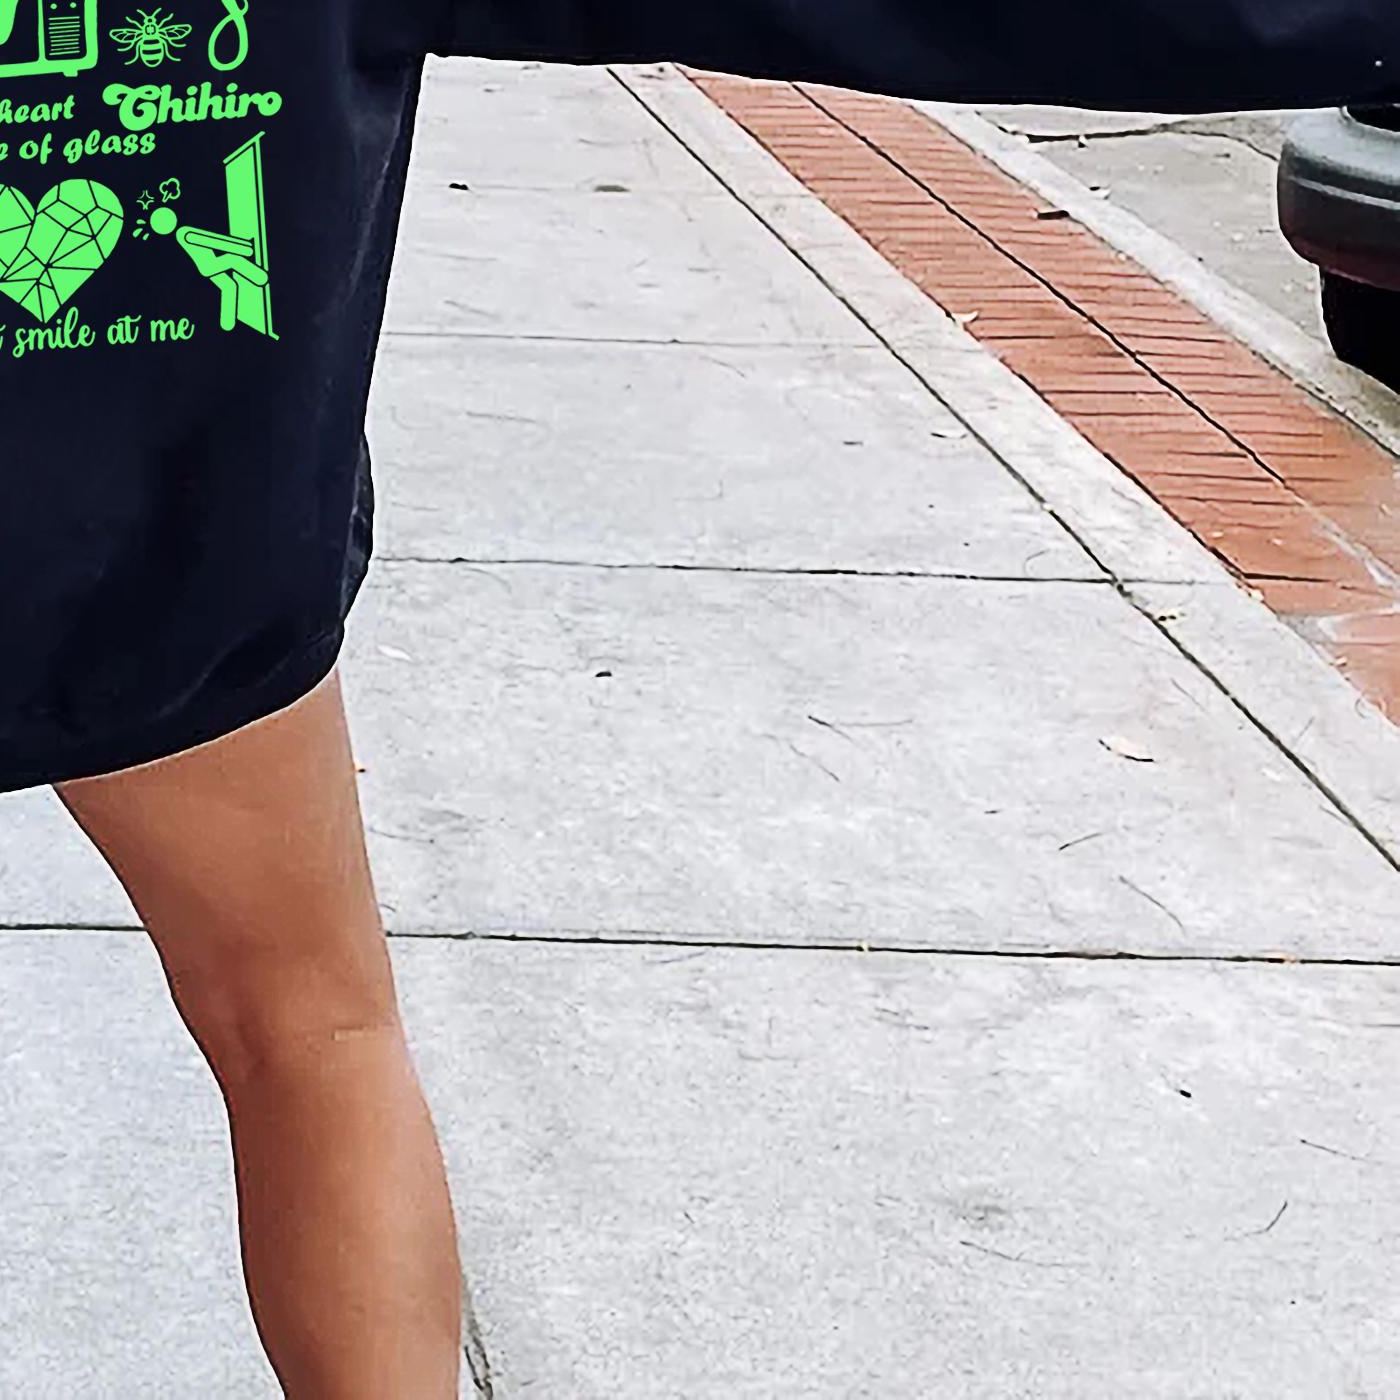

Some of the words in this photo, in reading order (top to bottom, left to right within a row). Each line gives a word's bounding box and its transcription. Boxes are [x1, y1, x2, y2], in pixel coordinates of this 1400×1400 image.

[102, 80, 284, 133] Chihiro
[18, 131, 54, 166] of
[64, 128, 157, 165] glass
[11, 305, 97, 359] smile
[106, 314, 143, 346] at
[149, 316, 196, 343] me
